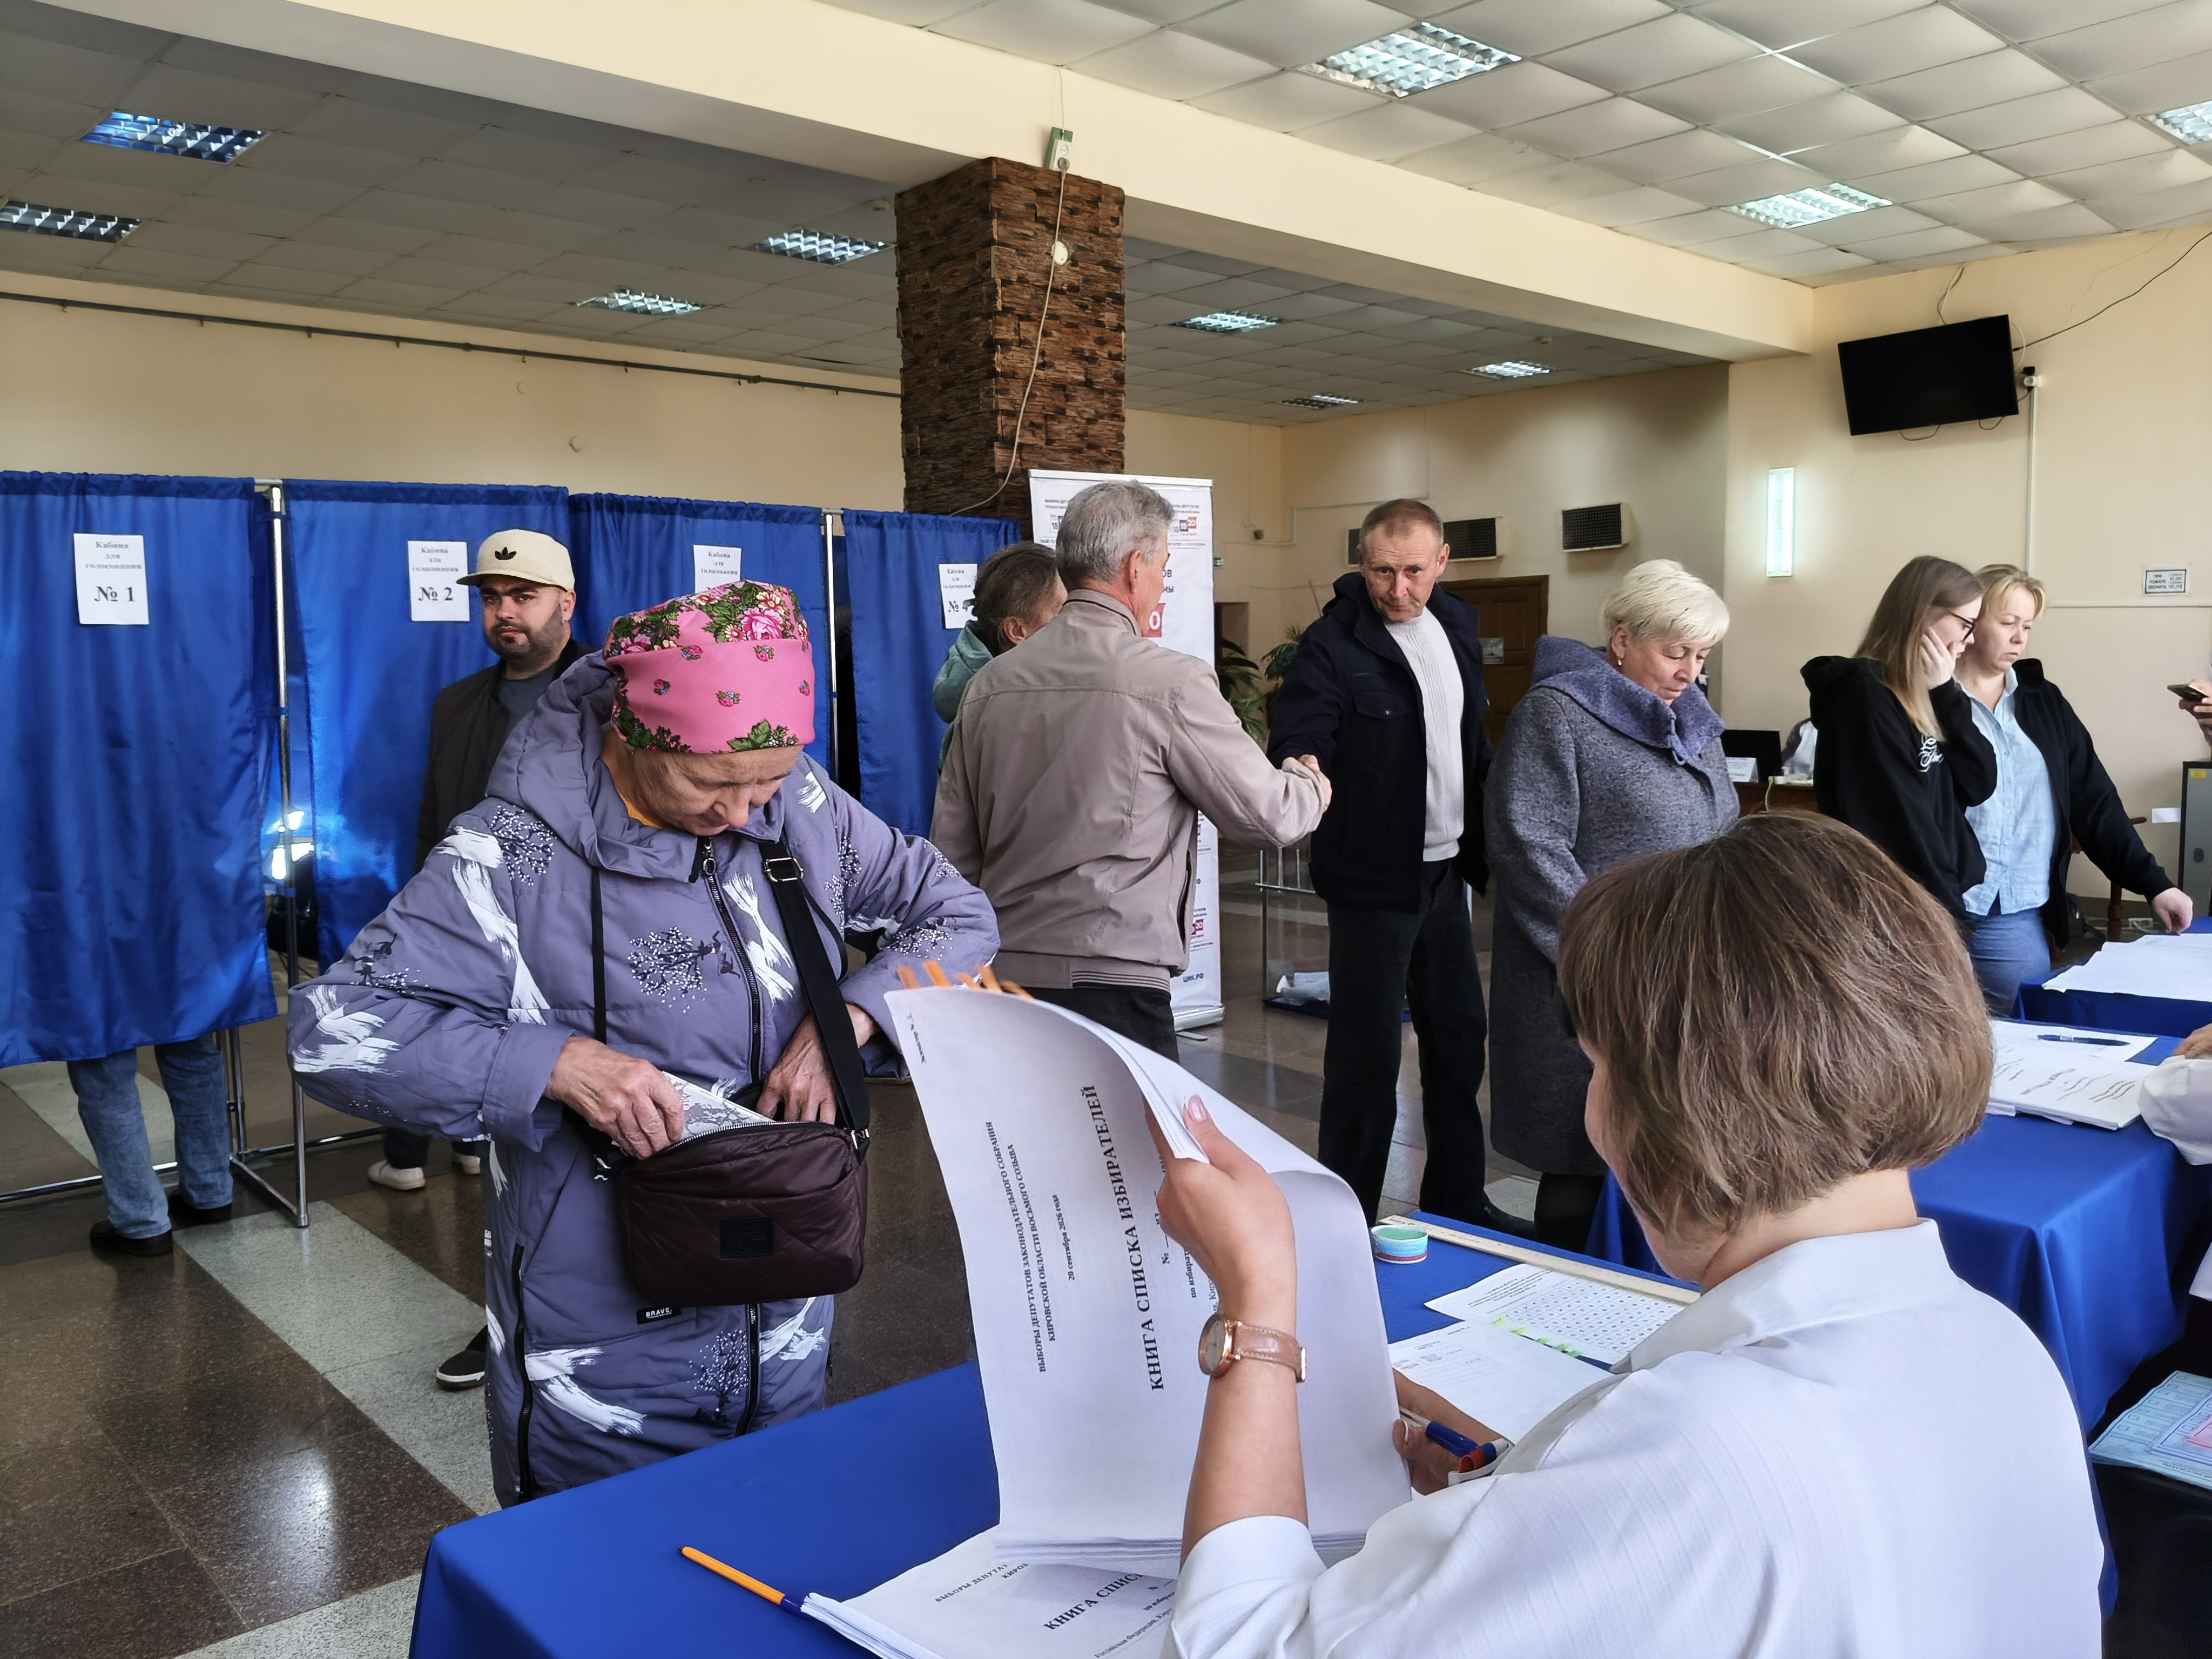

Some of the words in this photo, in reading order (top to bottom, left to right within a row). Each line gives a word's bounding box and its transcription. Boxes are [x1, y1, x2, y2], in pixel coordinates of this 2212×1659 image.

[94, 586, 118, 602] №
[126, 586, 135, 602] 1
[418, 586, 438, 602] №
[444, 586, 454, 601] 2
[948, 601, 959, 613] №
[986, 1122, 1005, 1170] СОБРАНИЯ
[1007, 1144, 1023, 1181] СОЗЫВА
[1081, 1084, 1134, 1220] ИЗБИРАТЕЛЕЙ
[1001, 1170, 1030, 1268] ЗАКОНОДАТЕЛЬНОГО
[1018, 1182, 1037, 1232] ВОСЬМОГО
[1053, 1195, 1061, 1212] года
[1056, 1212, 1066, 1231] 2026
[1032, 1233, 1046, 1279] ОБЛАСТИ
[1062, 1232, 1073, 1270] сентября
[1124, 1225, 1150, 1312] СПИСКА
[1067, 1271, 1075, 1281] 20
[1190, 1287, 1197, 1298] по
[1024, 1269, 1040, 1328] ДЕПУТАТОВ
[1039, 1281, 1055, 1341] КИРОВСКОЙ
[1033, 1329, 1046, 1373] ВЫБОРЫ
[1141, 1318, 1164, 1391] КНИГА
[935, 1583, 972, 1603] ВЫБОРЫ
[972, 1564, 1008, 1584] ДЕПУТА
[1043, 1599, 1098, 1630] КНИГА
[1096, 1573, 1143, 1598] СПИС
